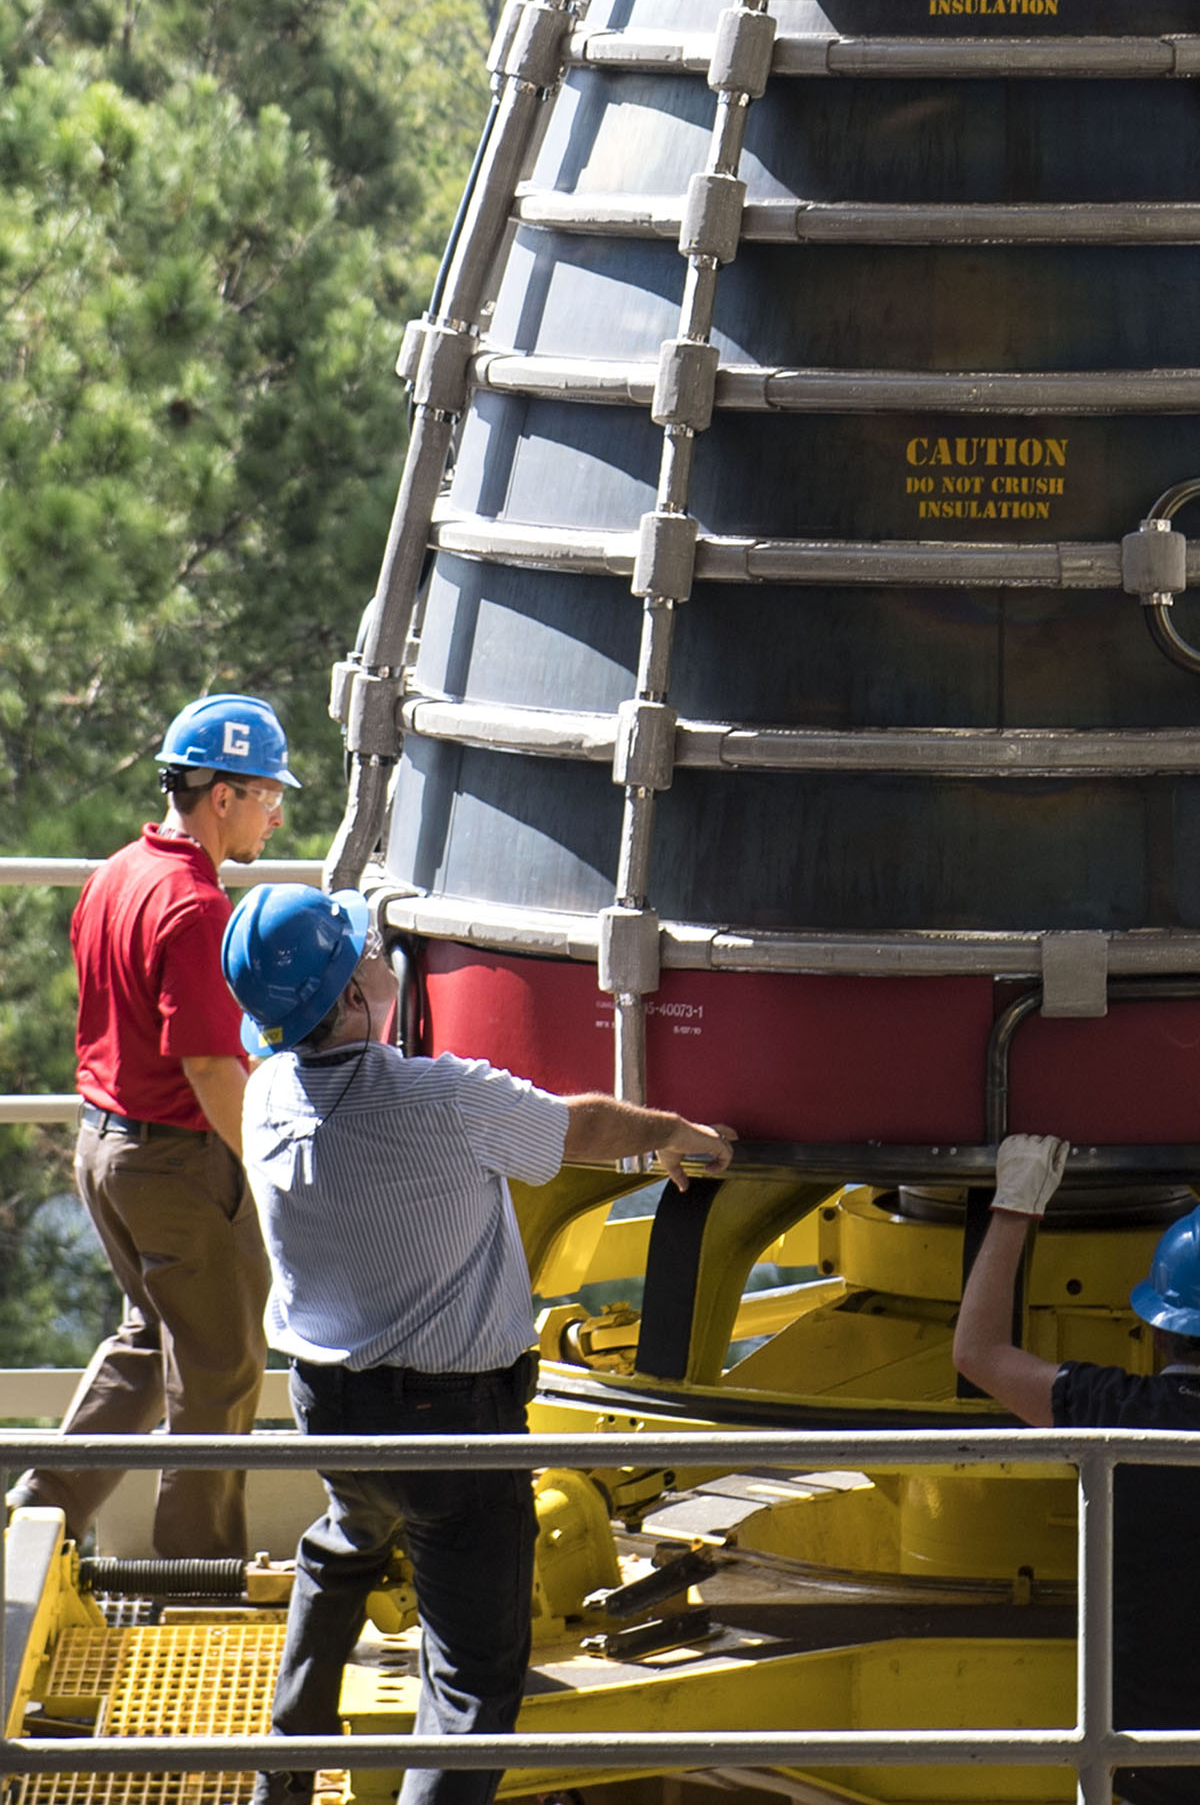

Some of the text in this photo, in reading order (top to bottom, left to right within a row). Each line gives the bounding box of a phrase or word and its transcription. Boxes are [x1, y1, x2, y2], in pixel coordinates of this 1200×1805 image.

[906, 437, 1068, 467] CAUTION
[906, 475, 1064, 495] DO NOT CRUSH
[919, 500, 1049, 519] INSULATION
[223, 721, 251, 757] G
